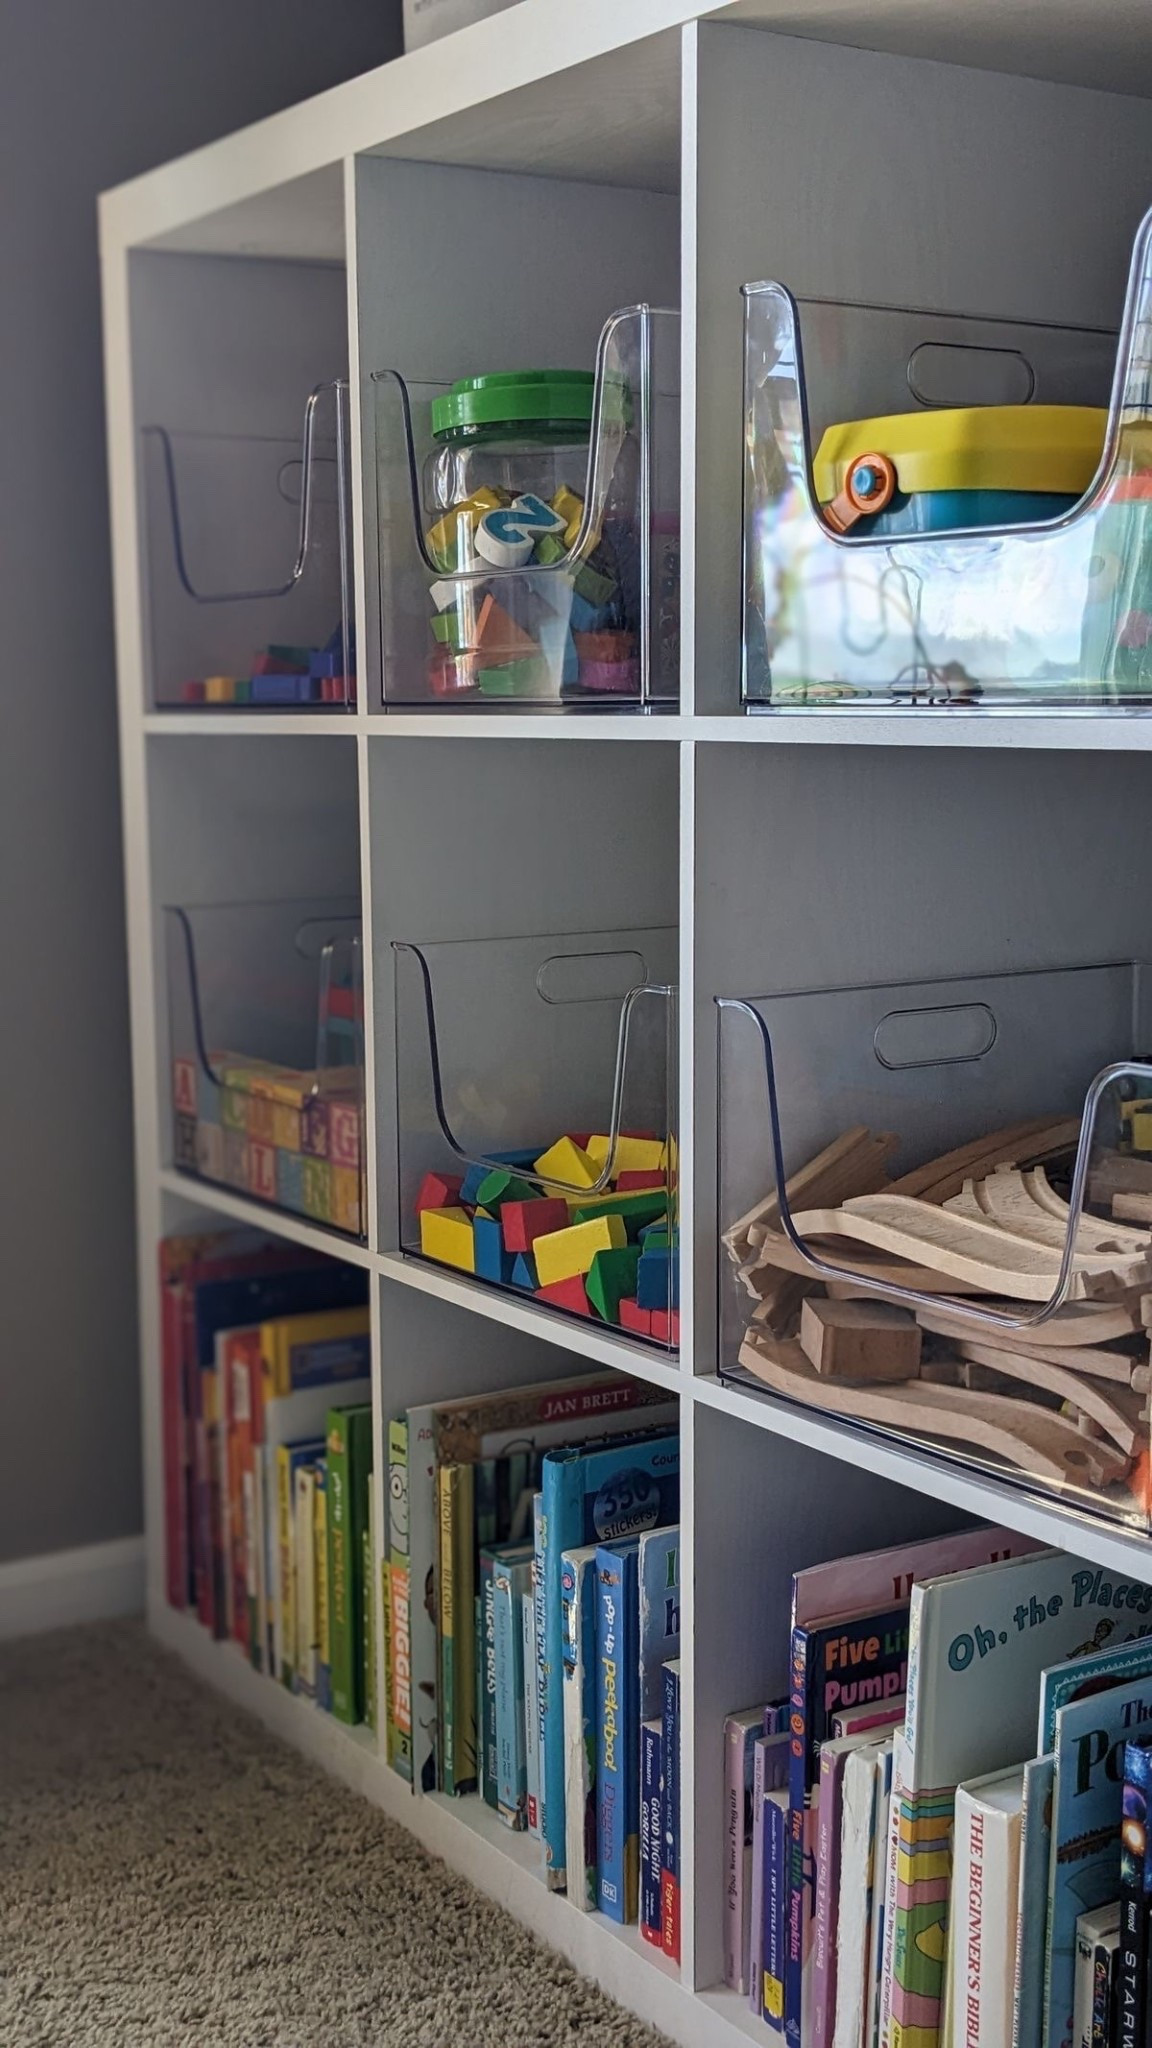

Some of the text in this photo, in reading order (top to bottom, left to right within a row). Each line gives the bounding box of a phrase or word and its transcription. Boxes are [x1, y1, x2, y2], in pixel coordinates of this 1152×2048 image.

[544, 1388, 631, 1419] JAN BRETT
[442, 1568, 452, 1619] BELOW
[825, 1635, 880, 1672] Five
[948, 1624, 1008, 1672] Oh,
[1013, 1595, 1063, 1632] the
[394, 1595, 411, 1727] BIGGIE!
[600, 1594, 619, 1862] pop-up peekaboo! Diggers
[645, 1737, 655, 1786] Rathmann
[641, 1801, 651, 1861] GORILLA
[650, 1796, 661, 1835] GOOD
[728, 1788, 738, 1837] Penguin
[969, 1813, 984, 1858] THE
[890, 1844, 898, 1871] MOM
[789, 1809, 803, 1962] Five Little Pumpkins
[665, 1882, 674, 1947] tiger tales
[885, 1919, 895, 1940] Very
[967, 1860, 983, 1992] BEGINNER'S
[1127, 1901, 1137, 1933] Kerrod
[884, 1941, 893, 1975] Hungry
[882, 1976, 892, 2027] Caterpillar
[1093, 1961, 1107, 2040] Chalk Art
